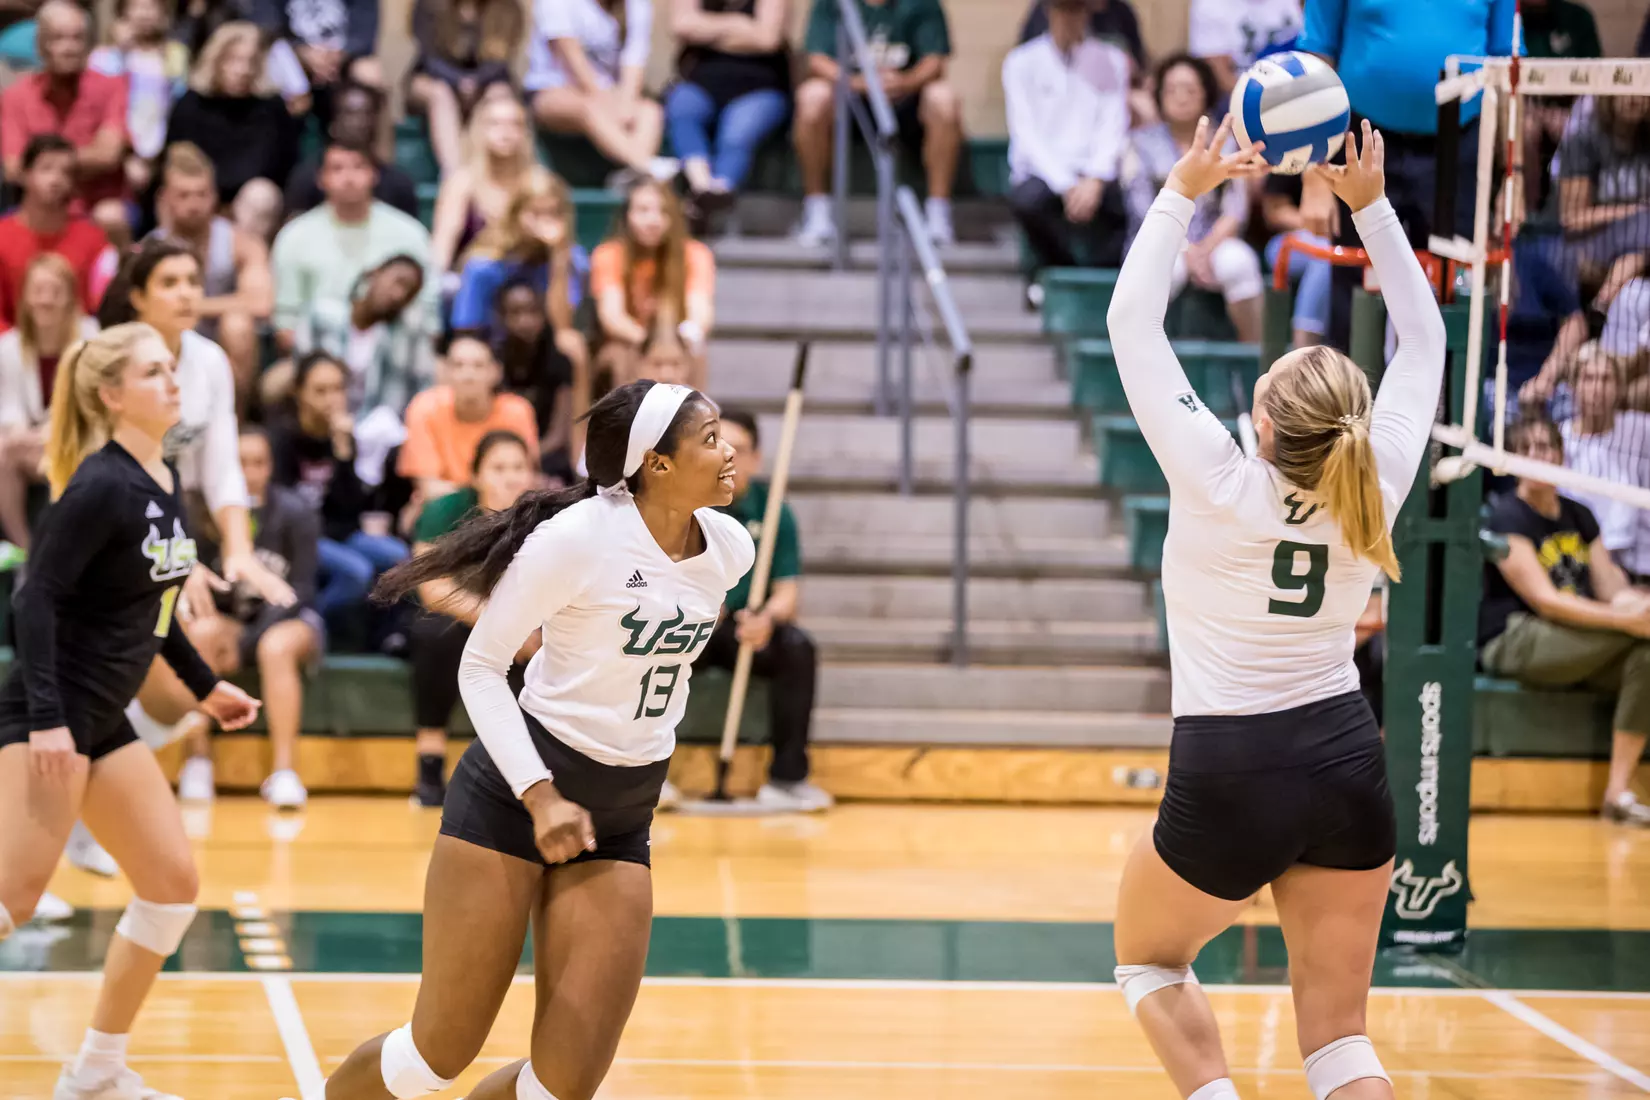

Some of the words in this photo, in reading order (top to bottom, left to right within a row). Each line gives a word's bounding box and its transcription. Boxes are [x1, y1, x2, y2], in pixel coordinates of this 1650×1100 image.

[625, 580, 648, 588] adidas
[1268, 540, 1329, 618] 9
[153, 585, 179, 638] 1
[619, 603, 716, 657] USF
[633, 663, 681, 721] 13
